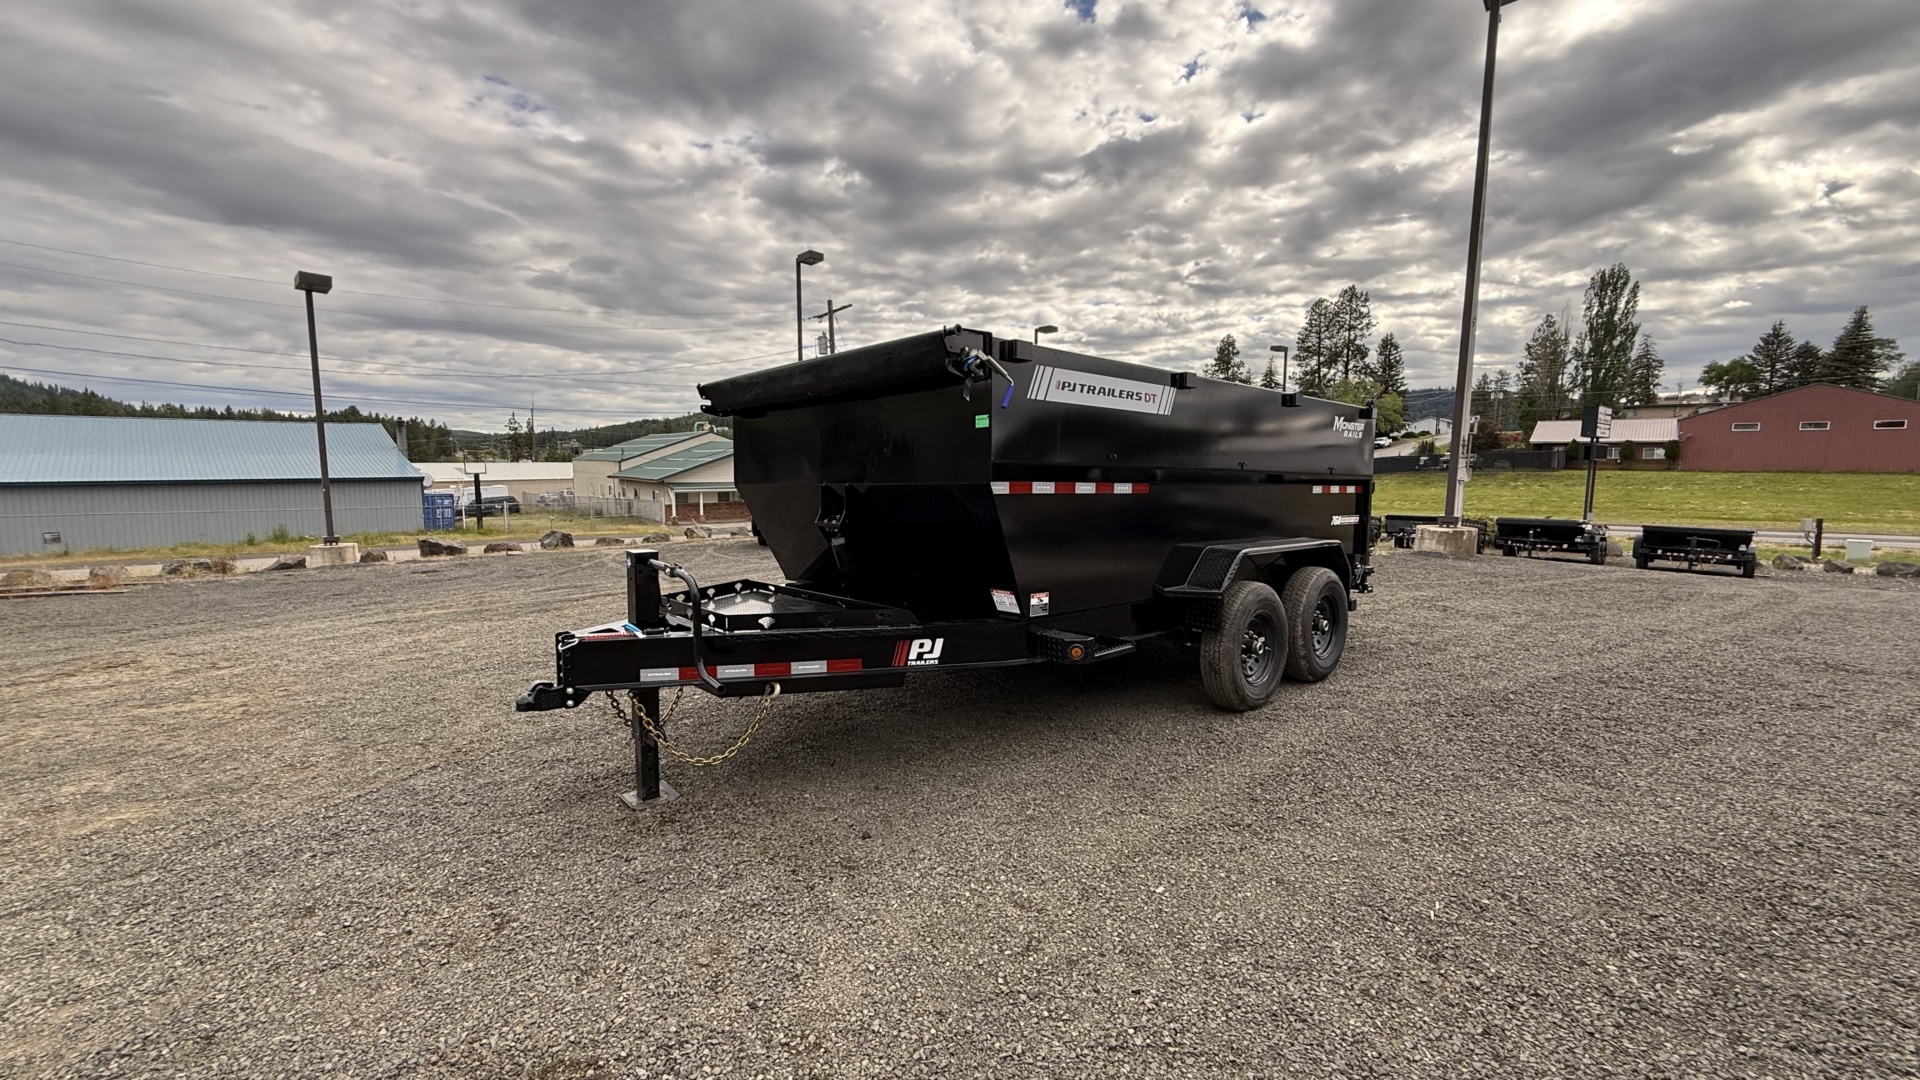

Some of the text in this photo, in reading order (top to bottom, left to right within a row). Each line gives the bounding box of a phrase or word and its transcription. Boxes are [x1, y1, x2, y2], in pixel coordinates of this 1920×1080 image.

[1061, 380, 1158, 404] PJ TRAILERS DT
[1343, 430, 1363, 439] RAILS
[908, 637, 944, 660] PJ
[907, 659, 939, 667] TRAILERS
